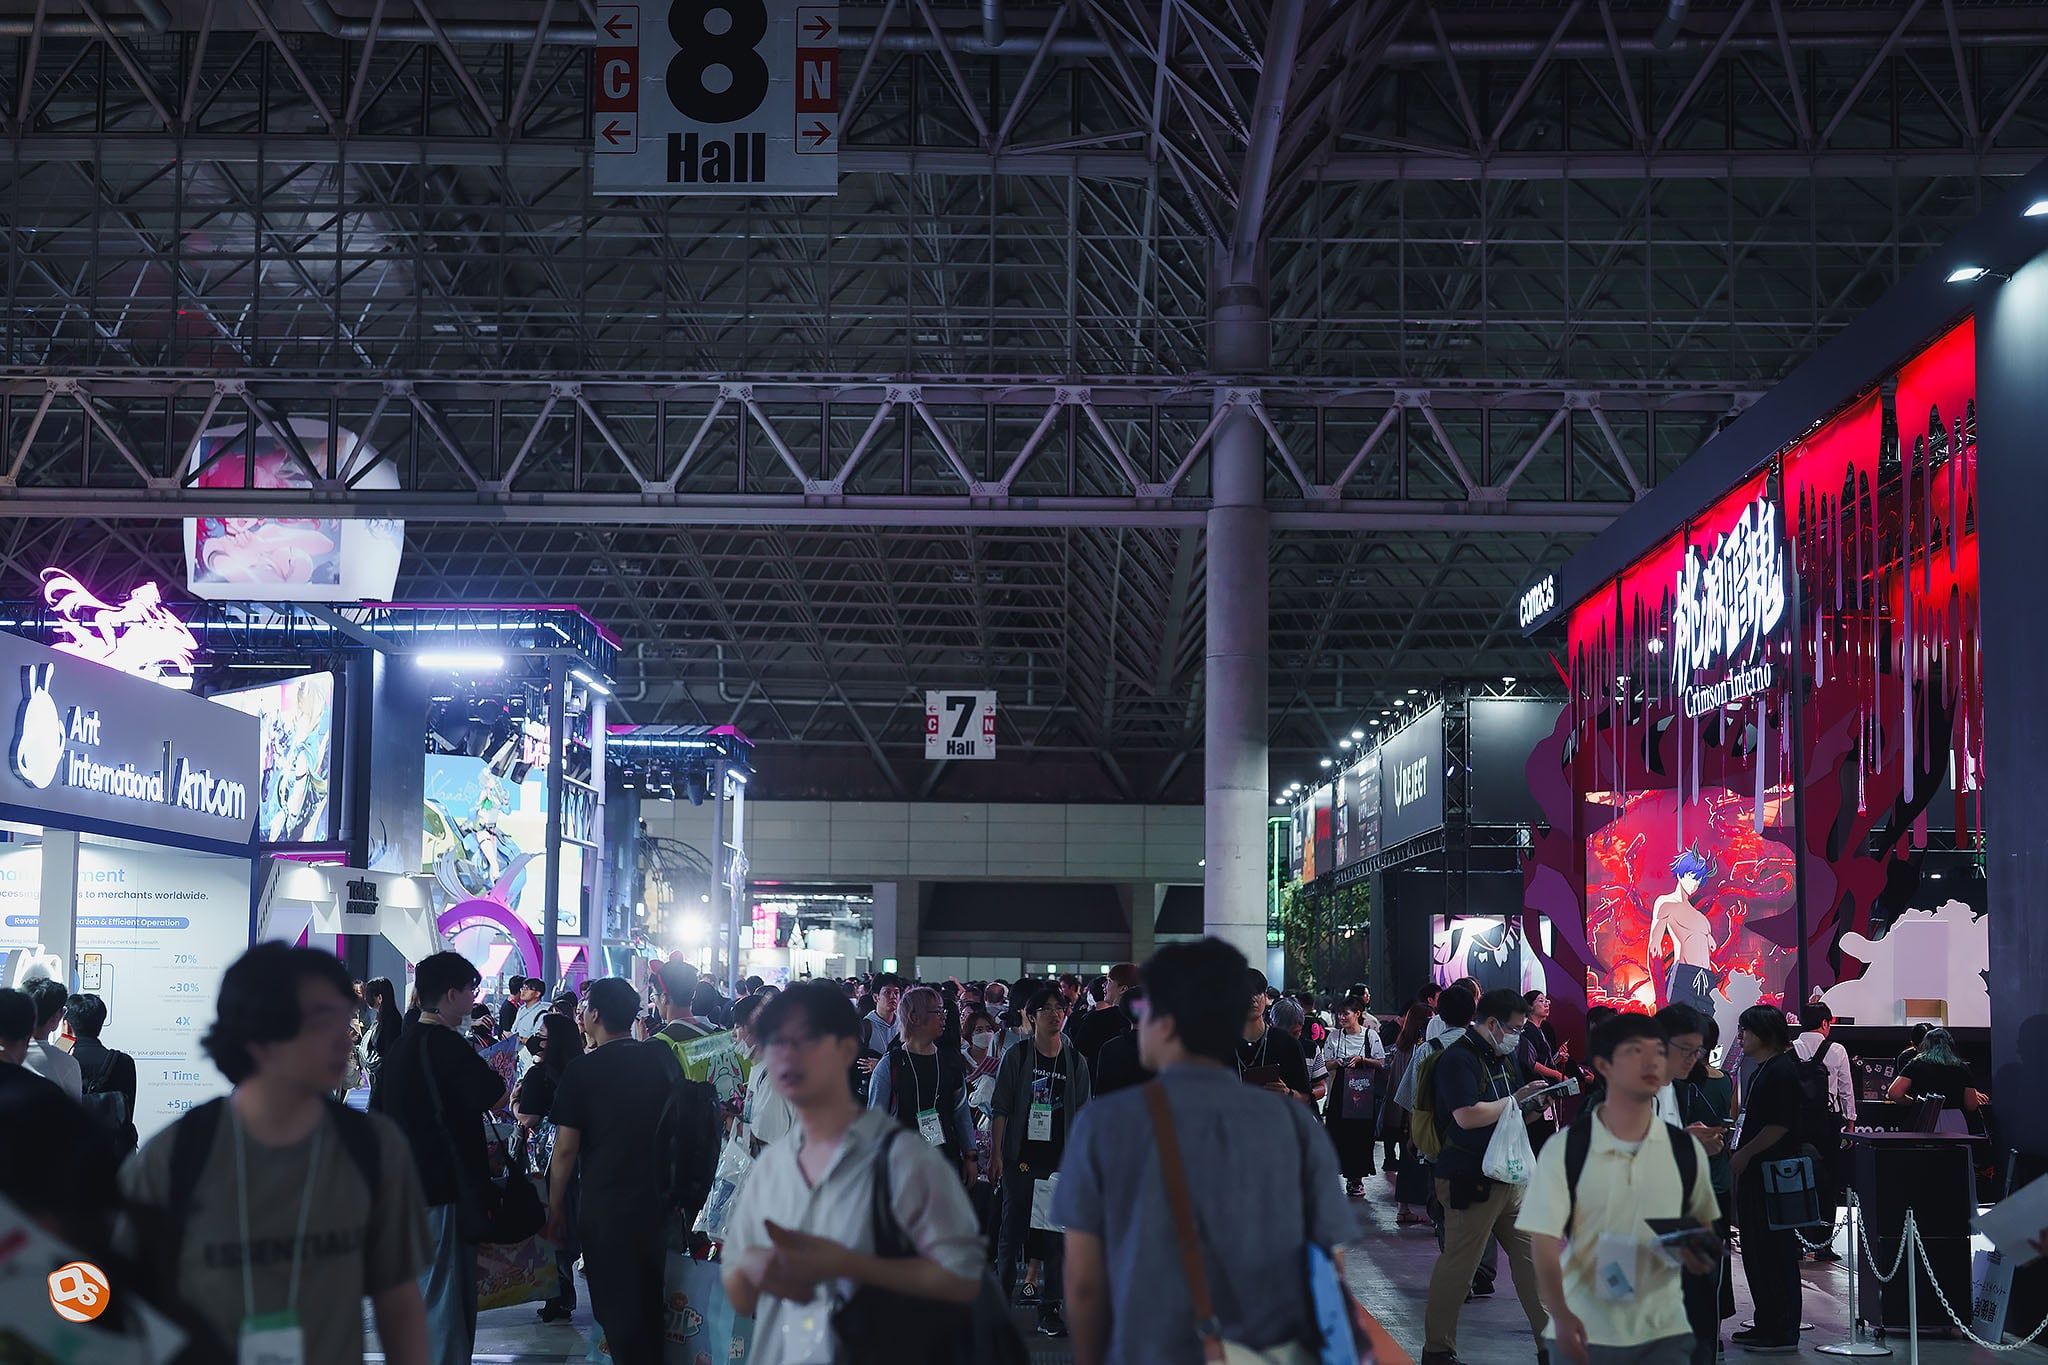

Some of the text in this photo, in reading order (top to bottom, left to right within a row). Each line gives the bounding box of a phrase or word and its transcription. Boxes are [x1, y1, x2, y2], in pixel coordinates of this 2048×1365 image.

[666, 0, 769, 123] 8
[603, 59, 631, 99] C
[803, 60, 832, 100] N
[667, 133, 766, 183] Hall
[1685, 662, 1772, 718] Crimson Inferno
[946, 696, 976, 738] 7
[69, 706, 101, 746] Ant
[927, 718, 937, 731] C
[984, 718, 994, 731] N
[946, 740, 975, 756] Hall
[69, 750, 247, 820] International Antom
[1402, 755, 1427, 807] REJECT
[98, 890, 153, 900] merchants
[155, 891, 209, 901] worldwide.
[14, 917, 39, 925] Reven
[76, 917, 180, 928] zation & Efficient Operation
[174, 954, 198, 964] 70%
[169, 983, 200, 993] ~30%
[175, 1016, 191, 1026] 4X
[163, 1070, 200, 1080] 1 Time
[167, 1099, 193, 1110] +5pt
